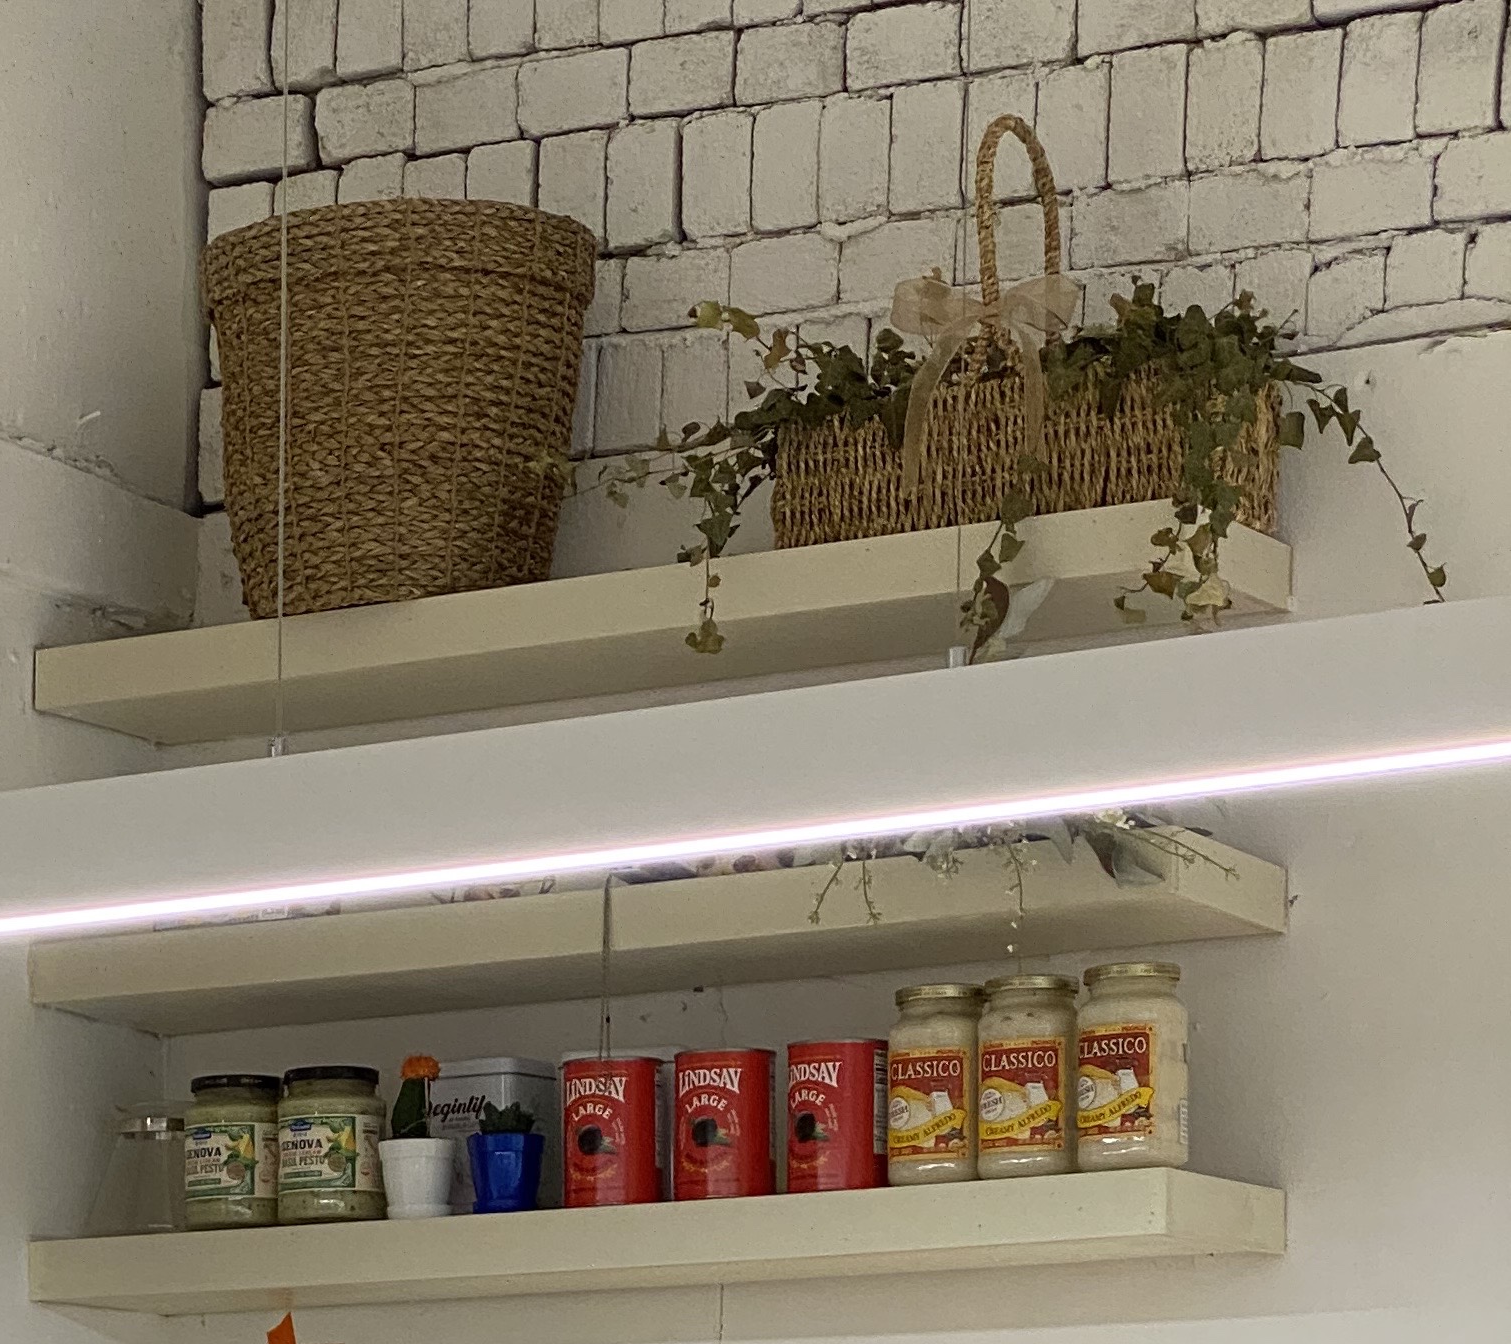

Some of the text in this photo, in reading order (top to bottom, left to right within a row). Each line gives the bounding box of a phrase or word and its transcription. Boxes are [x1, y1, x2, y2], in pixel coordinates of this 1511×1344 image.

[891, 1060, 961, 1080] CLASSICO
[982, 1051, 1056, 1071] CLASSICO
[572, 1102, 613, 1121] LARGE
[685, 1094, 728, 1113] LARGE
